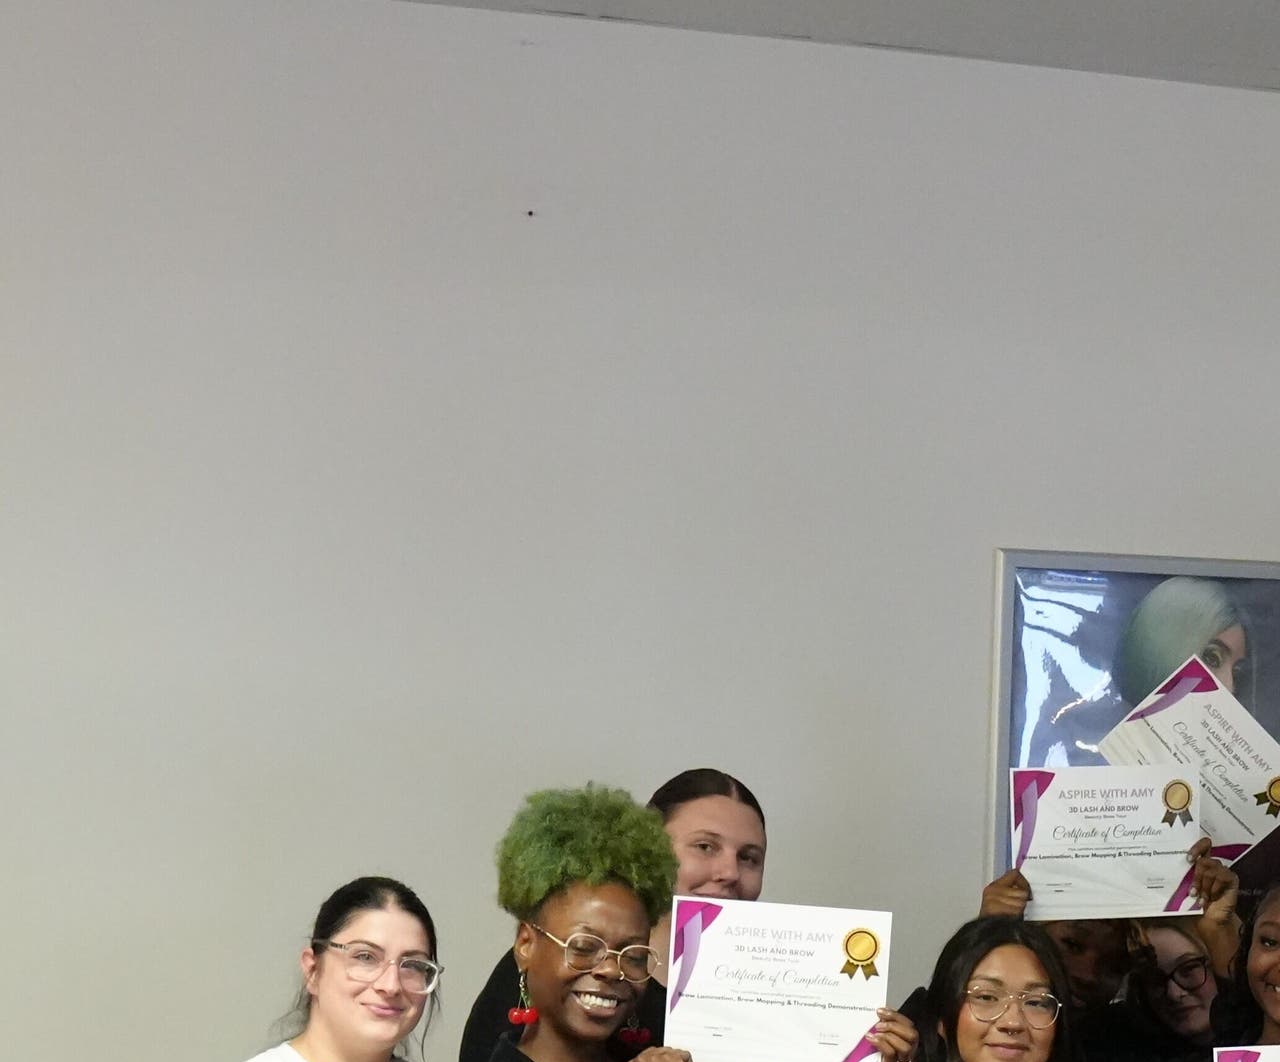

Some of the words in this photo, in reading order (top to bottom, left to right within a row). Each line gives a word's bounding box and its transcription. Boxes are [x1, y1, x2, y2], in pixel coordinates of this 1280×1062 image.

[1059, 789, 1097, 800] ASPIRE
[1100, 788, 1128, 798] WITH
[1130, 788, 1155, 798] AMY
[1100, 805, 1115, 813] AND
[1053, 825, 1098, 844] Certificate
[1101, 827, 1112, 842] of
[1113, 824, 1163, 840] Completion
[724, 925, 768, 939] ASPIRE
[771, 929, 803, 941] WITH
[805, 932, 835, 943] AMY
[747, 945, 768, 954] LASH
[769, 947, 788, 956] AND
[789, 948, 815, 958] BROW
